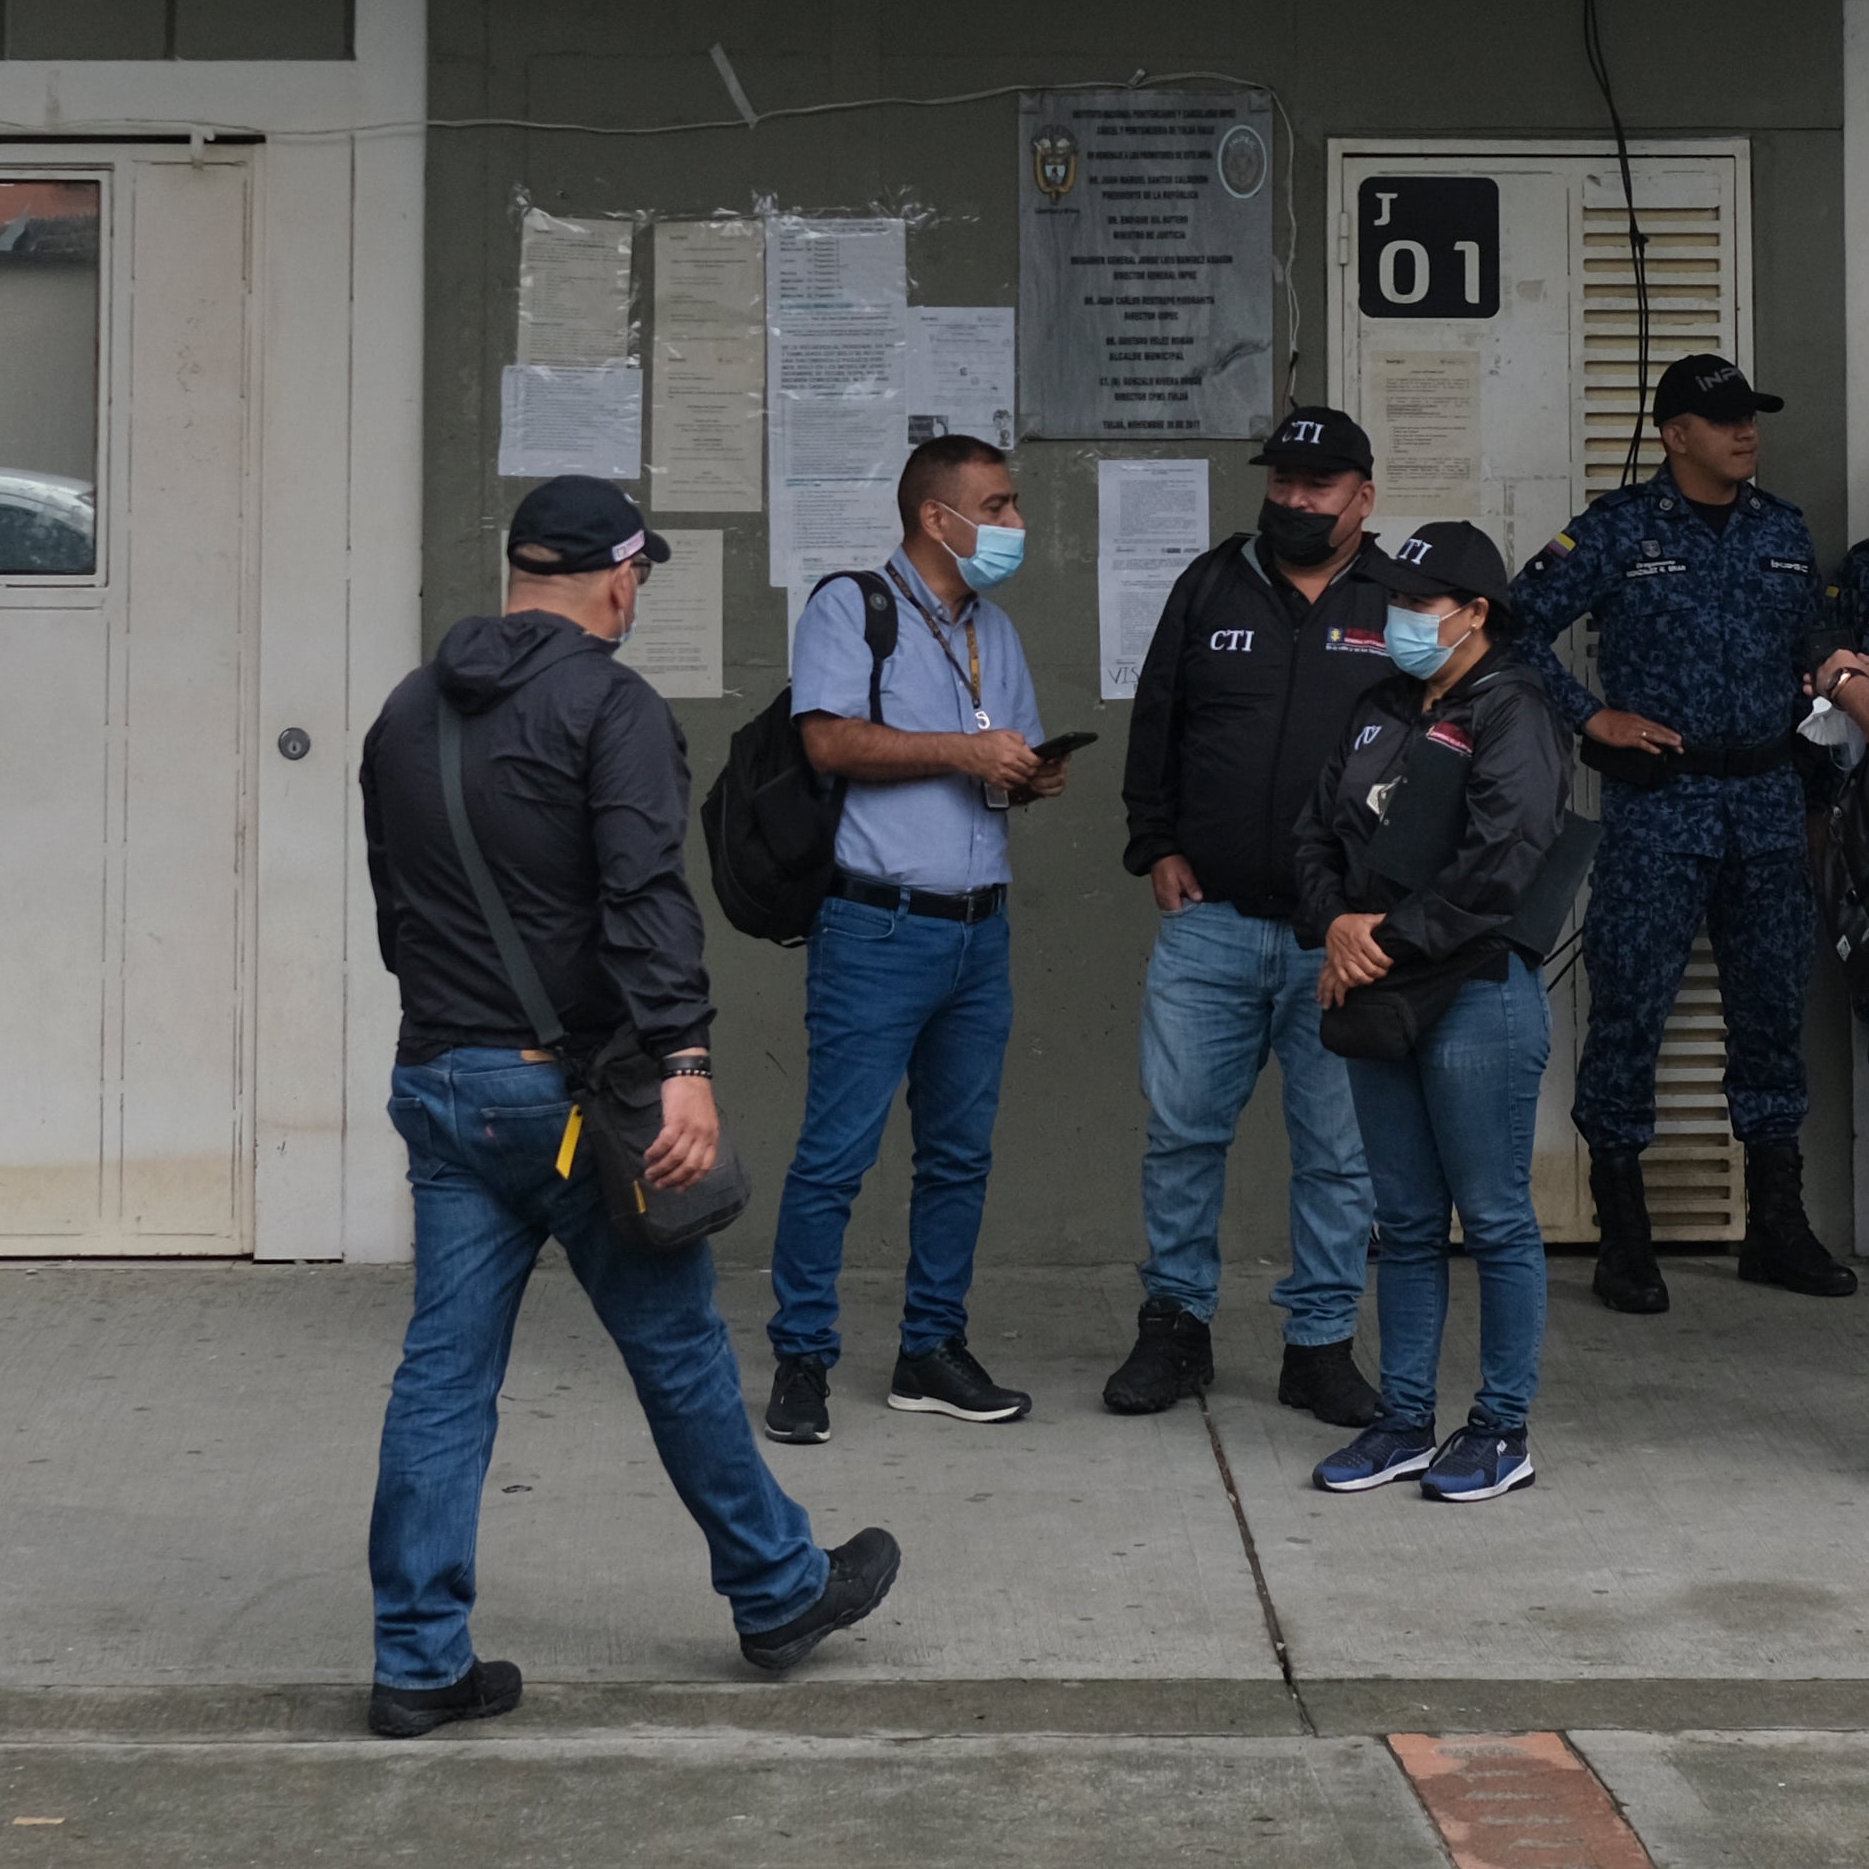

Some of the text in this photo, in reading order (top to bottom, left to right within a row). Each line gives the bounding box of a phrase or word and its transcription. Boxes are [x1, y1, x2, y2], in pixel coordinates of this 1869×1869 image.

[1373, 192, 1399, 227] J
[1378, 239, 1481, 305] 01
[1695, 367, 1743, 392] INP
[1398, 538, 1433, 565] TI
[1209, 629, 1255, 652] CTI
[1107, 666, 1140, 684] VIS
